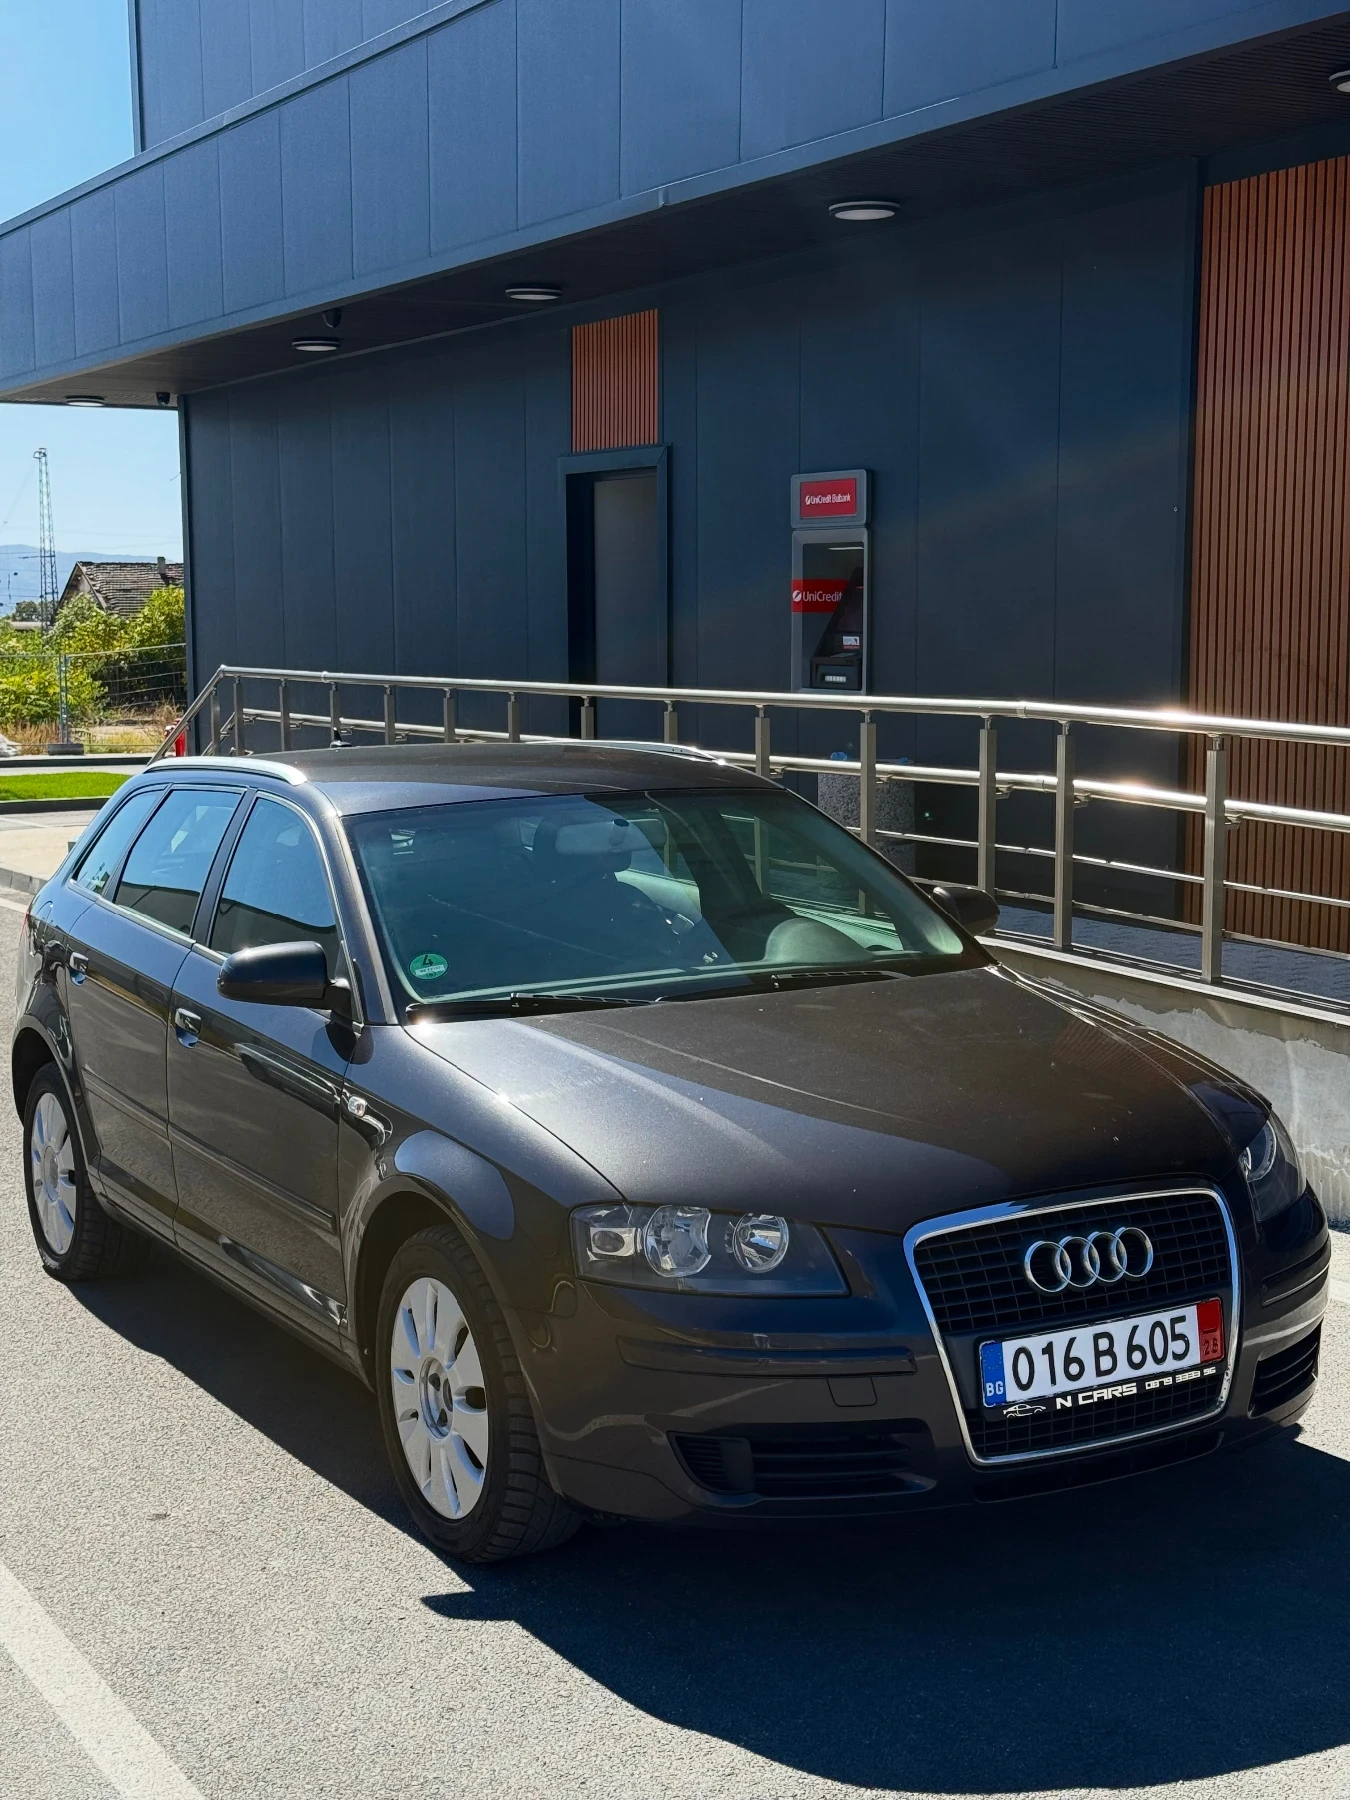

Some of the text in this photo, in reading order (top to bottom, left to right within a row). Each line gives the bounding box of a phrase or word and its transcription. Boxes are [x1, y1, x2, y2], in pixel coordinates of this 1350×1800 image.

[810, 493, 852, 505] UniCredit Bulbank
[802, 590, 843, 602] UniCredit
[422, 954, 434, 966] 4
[986, 1380, 1004, 1397] BG
[1056, 1395, 1072, 1410] N
[1078, 1382, 1137, 1406] CARS
[1145, 1376, 1173, 1390] 0879
